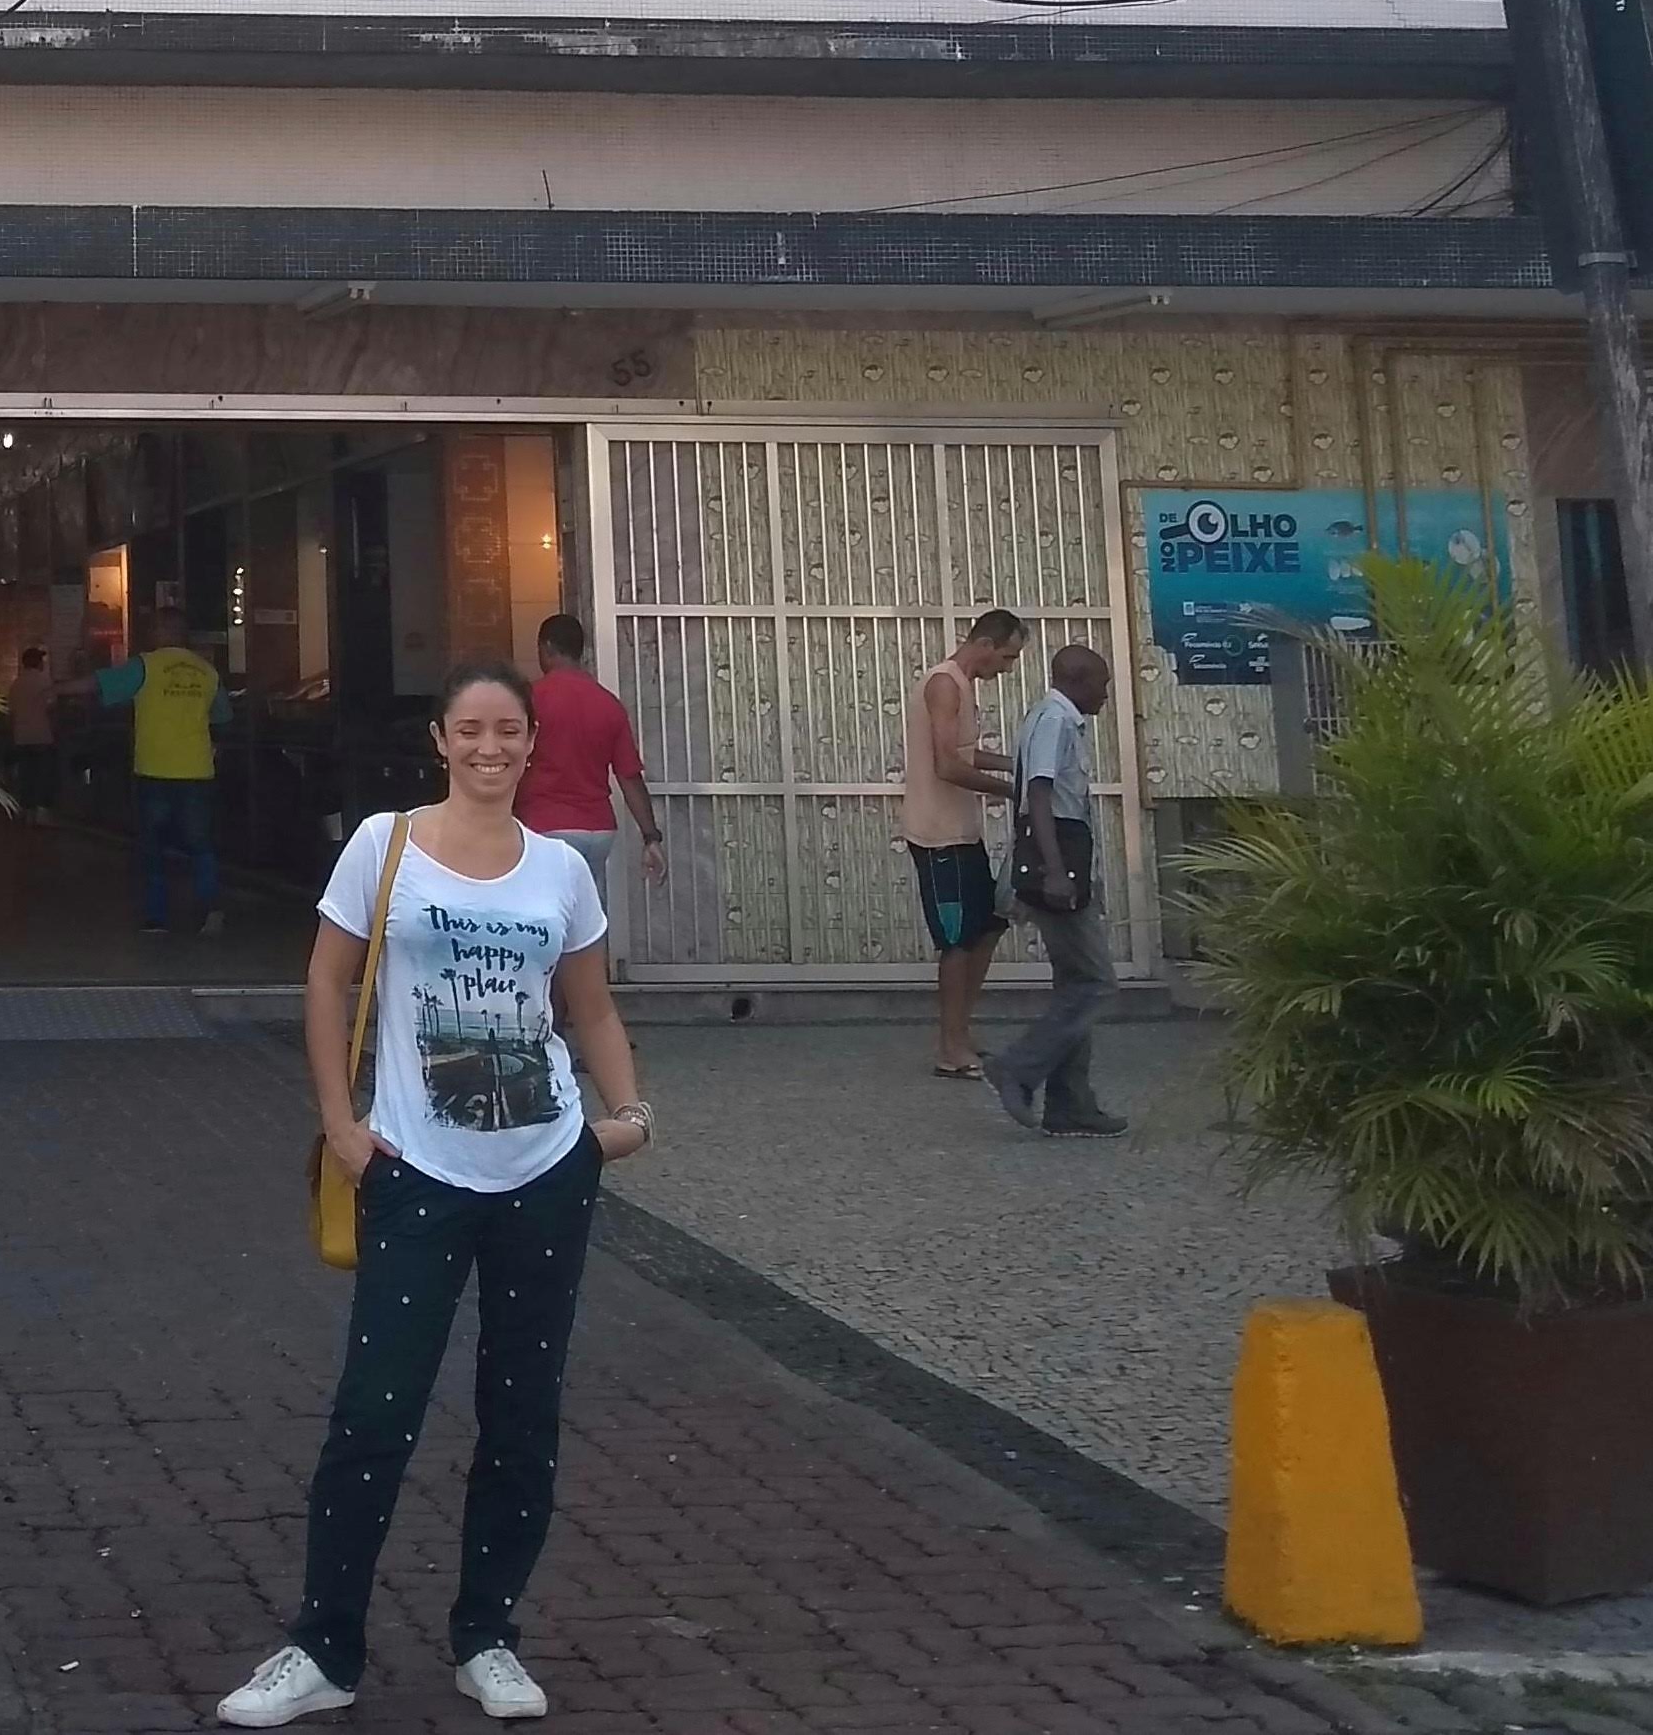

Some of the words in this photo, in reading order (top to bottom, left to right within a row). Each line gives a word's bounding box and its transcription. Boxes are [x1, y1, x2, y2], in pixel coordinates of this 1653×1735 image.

[1159, 512, 1178, 524] DE
[1160, 541, 1176, 573] NO
[1176, 541, 1301, 575] PEIXE
[421, 903, 481, 934] This
[485, 920, 511, 936] is
[515, 920, 550, 947] my
[450, 937, 526, 972] happy
[456, 967, 517, 1002] place
